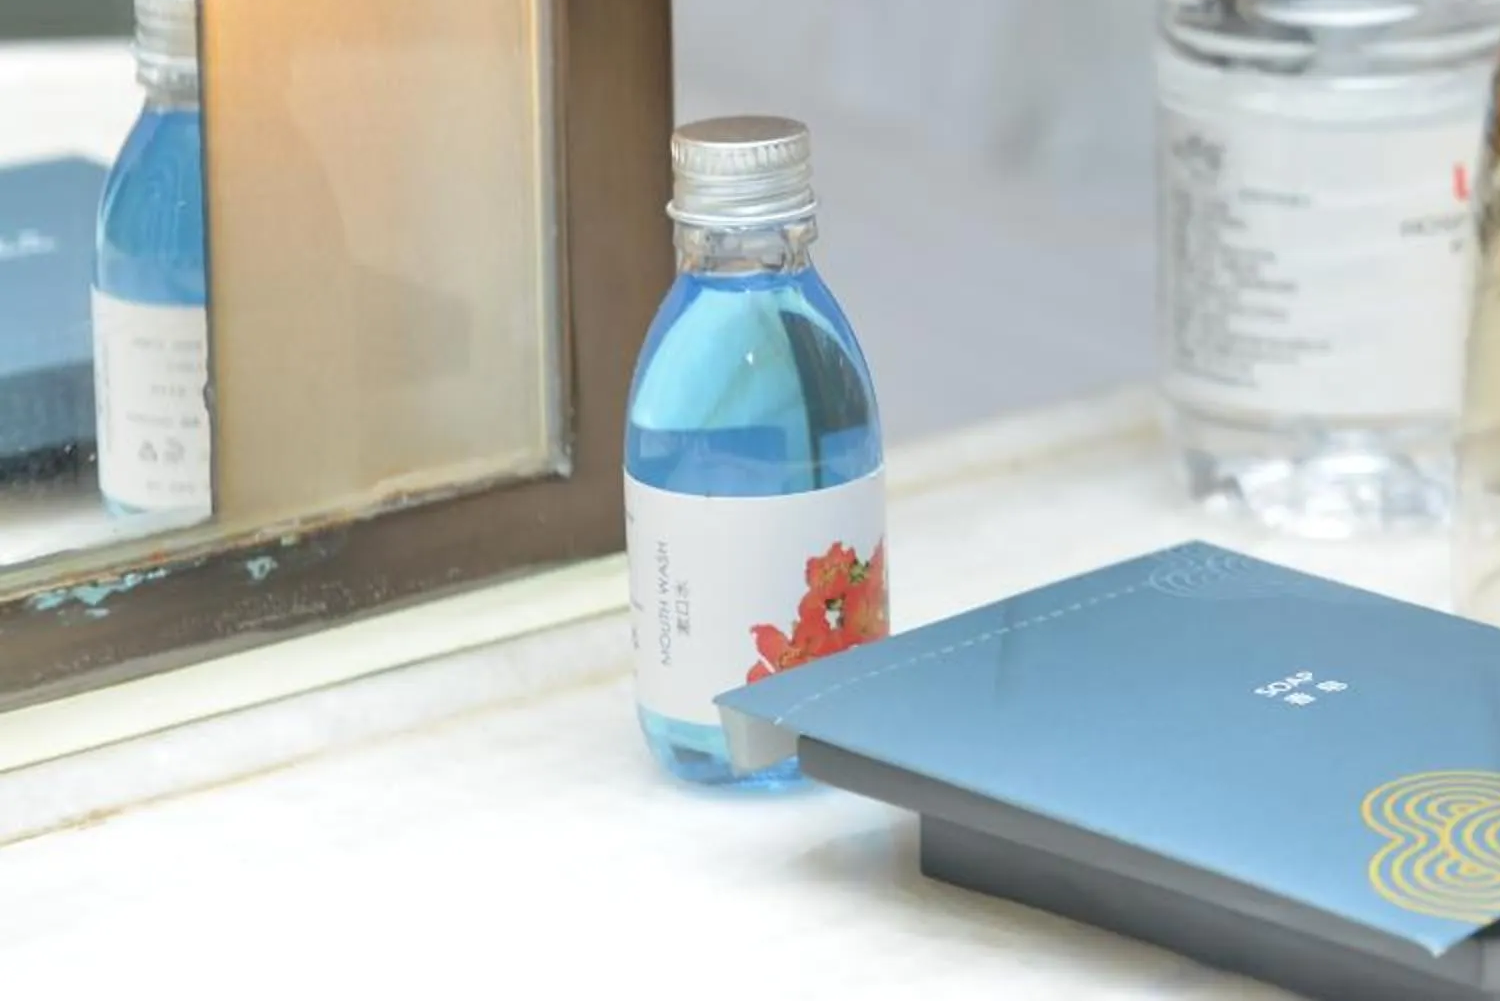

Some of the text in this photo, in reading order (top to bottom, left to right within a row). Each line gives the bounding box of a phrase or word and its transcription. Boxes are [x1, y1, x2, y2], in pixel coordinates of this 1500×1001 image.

[656, 539, 671, 666] MOUTH WASH
[1253, 671, 1313, 698] SOAP
